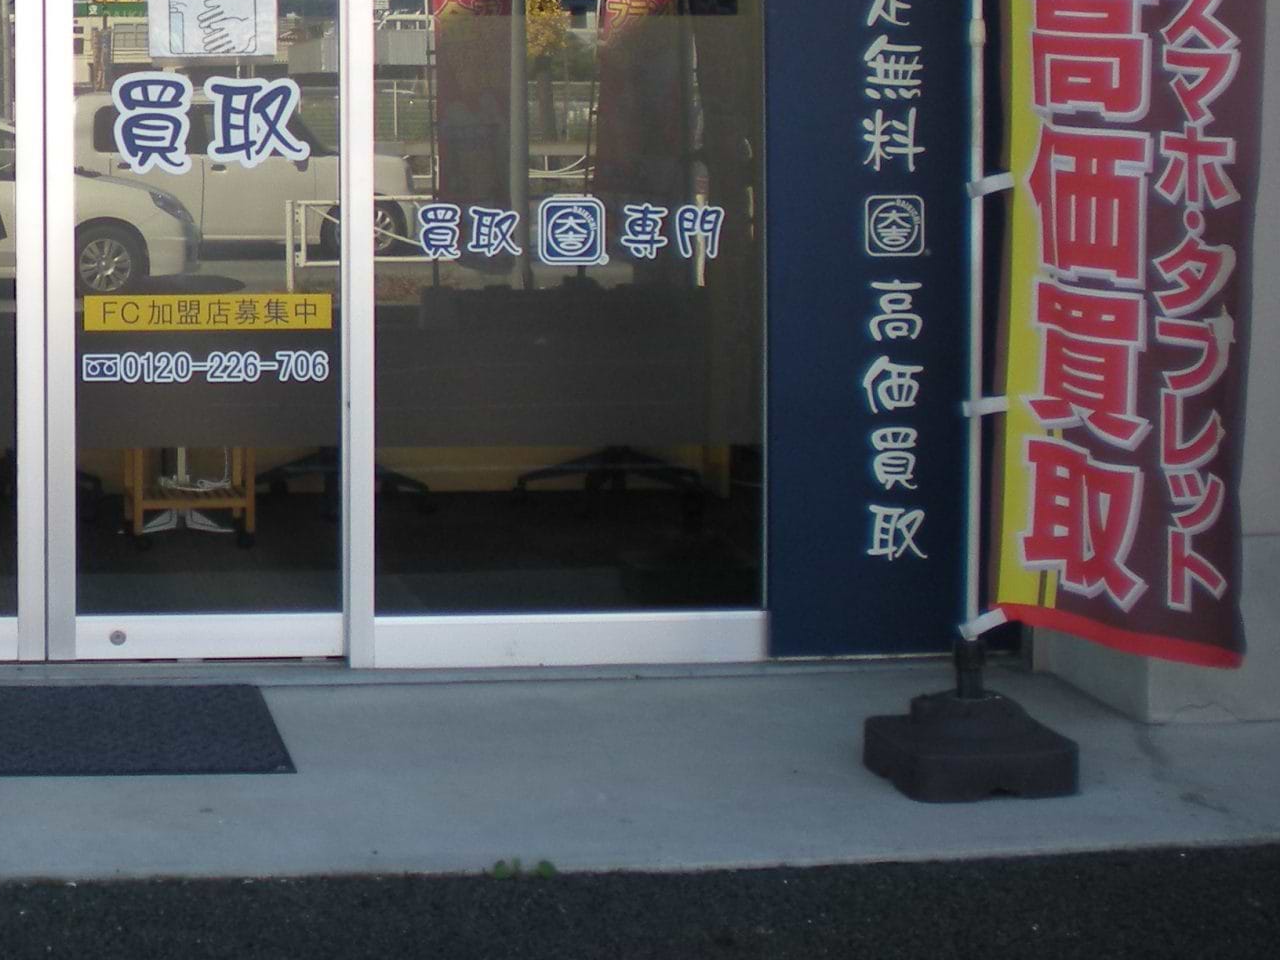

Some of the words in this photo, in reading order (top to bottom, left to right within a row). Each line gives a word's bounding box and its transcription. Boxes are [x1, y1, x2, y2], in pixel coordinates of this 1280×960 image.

[114, 73, 308, 173] 買取
[419, 203, 522, 259] 買取
[620, 203, 725, 259] 専門
[121, 350, 329, 382] 0120-226-706
[863, 280, 927, 560] 高価買取
